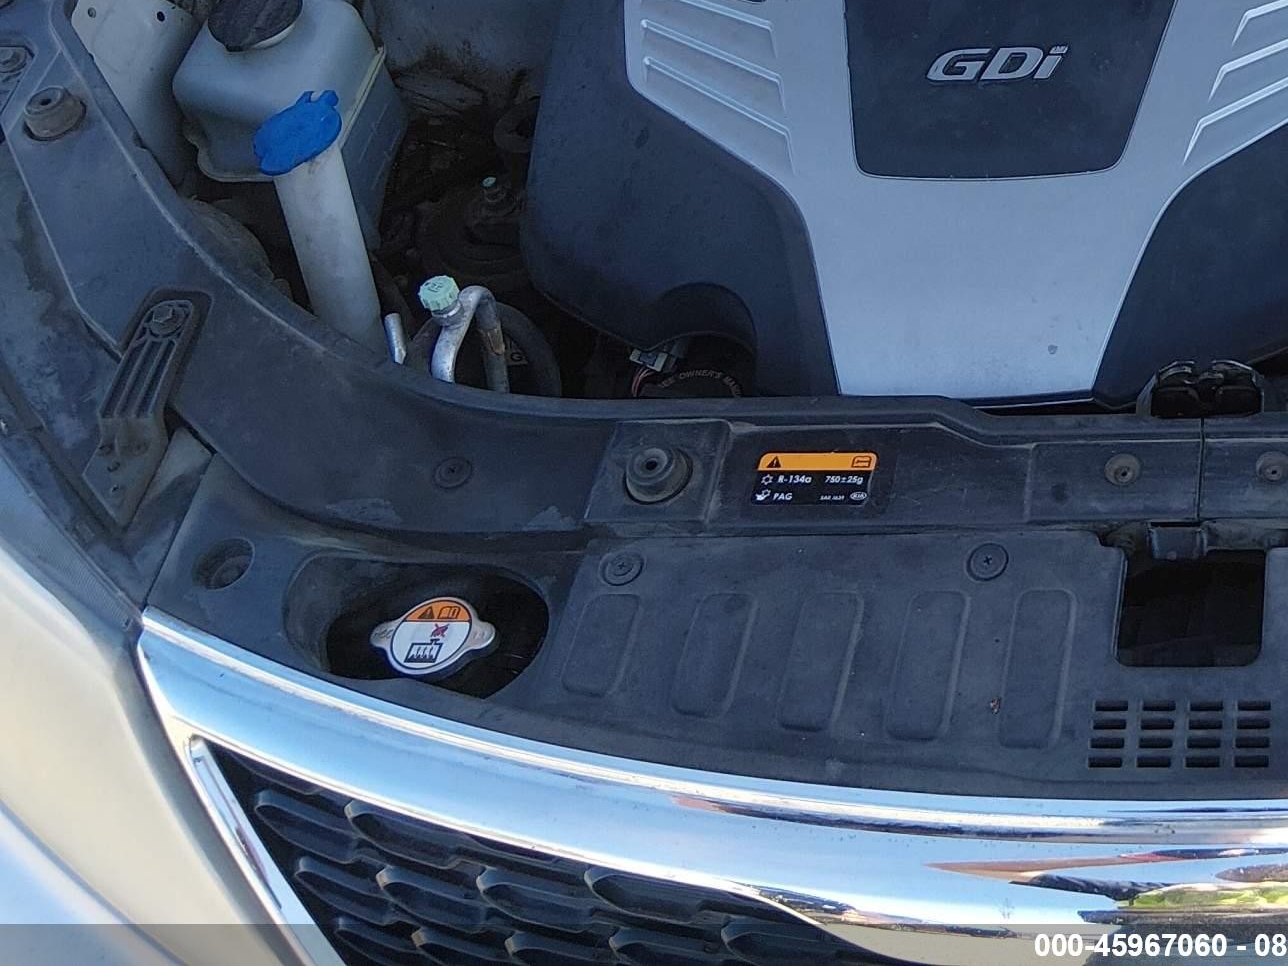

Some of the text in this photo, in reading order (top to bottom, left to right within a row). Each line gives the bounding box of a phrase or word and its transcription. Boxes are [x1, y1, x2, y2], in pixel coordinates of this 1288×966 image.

[926, 45, 1069, 81] GDi
[777, 474, 864, 486] R-134a 750±25g
[772, 492, 793, 501] PAG
